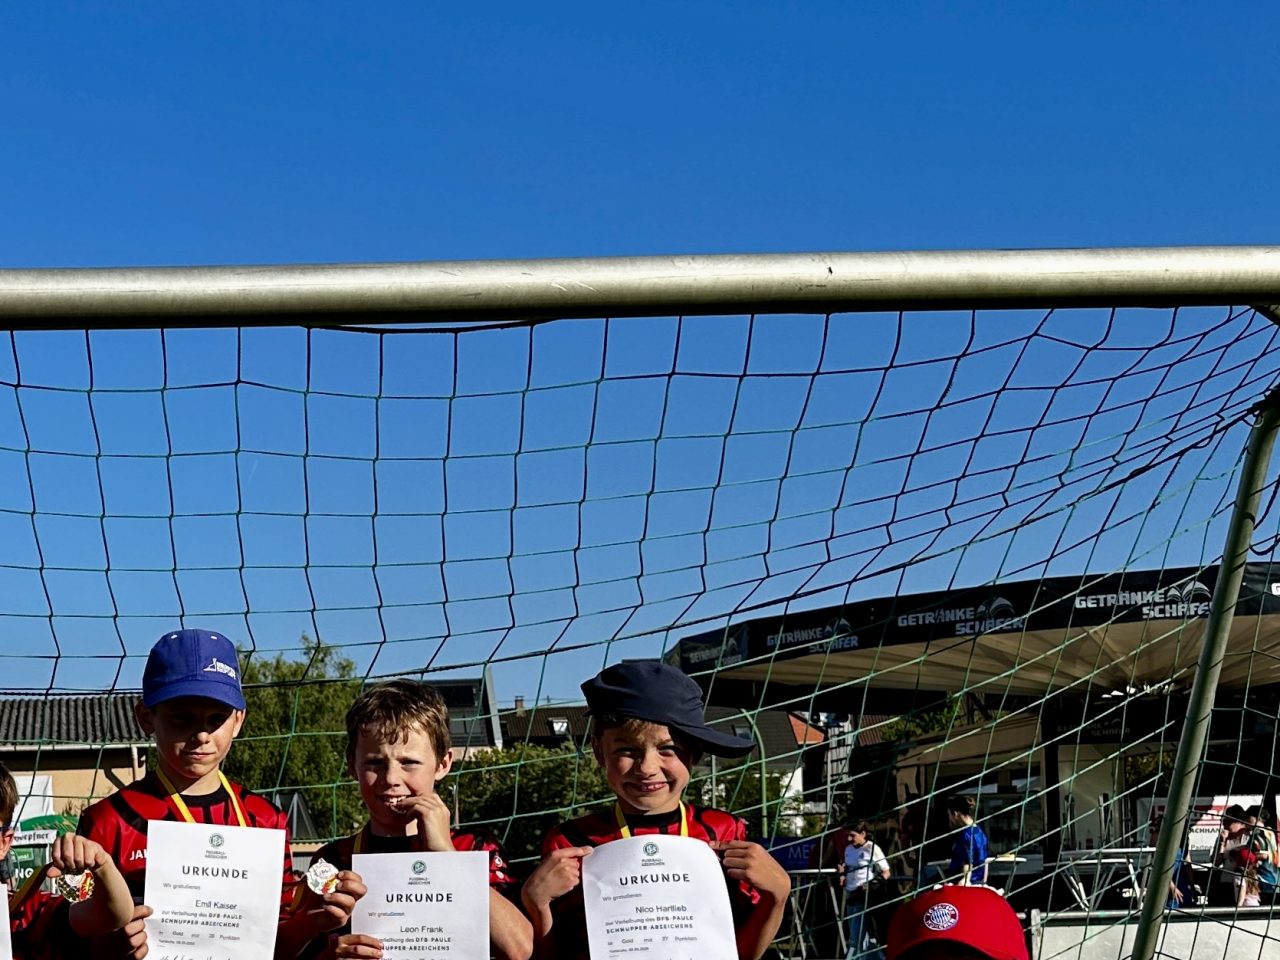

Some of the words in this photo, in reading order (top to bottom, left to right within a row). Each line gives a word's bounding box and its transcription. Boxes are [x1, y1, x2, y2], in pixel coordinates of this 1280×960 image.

[1075, 589, 1165, 609] GETRÄNKE
[898, 606, 975, 627] GETRÄNKE
[955, 615, 1024, 635] SCHÄFER
[767, 627, 823, 646] GETRÄNKE
[15, 832, 50, 843] oepfner
[182, 865, 249, 880] URKUNDE
[620, 873, 690, 886] URKUNDE
[195, 899, 211, 908] Emil
[213, 900, 237, 910] Kaiser
[386, 893, 453, 903] URKUNDE
[635, 906, 654, 914] Nico
